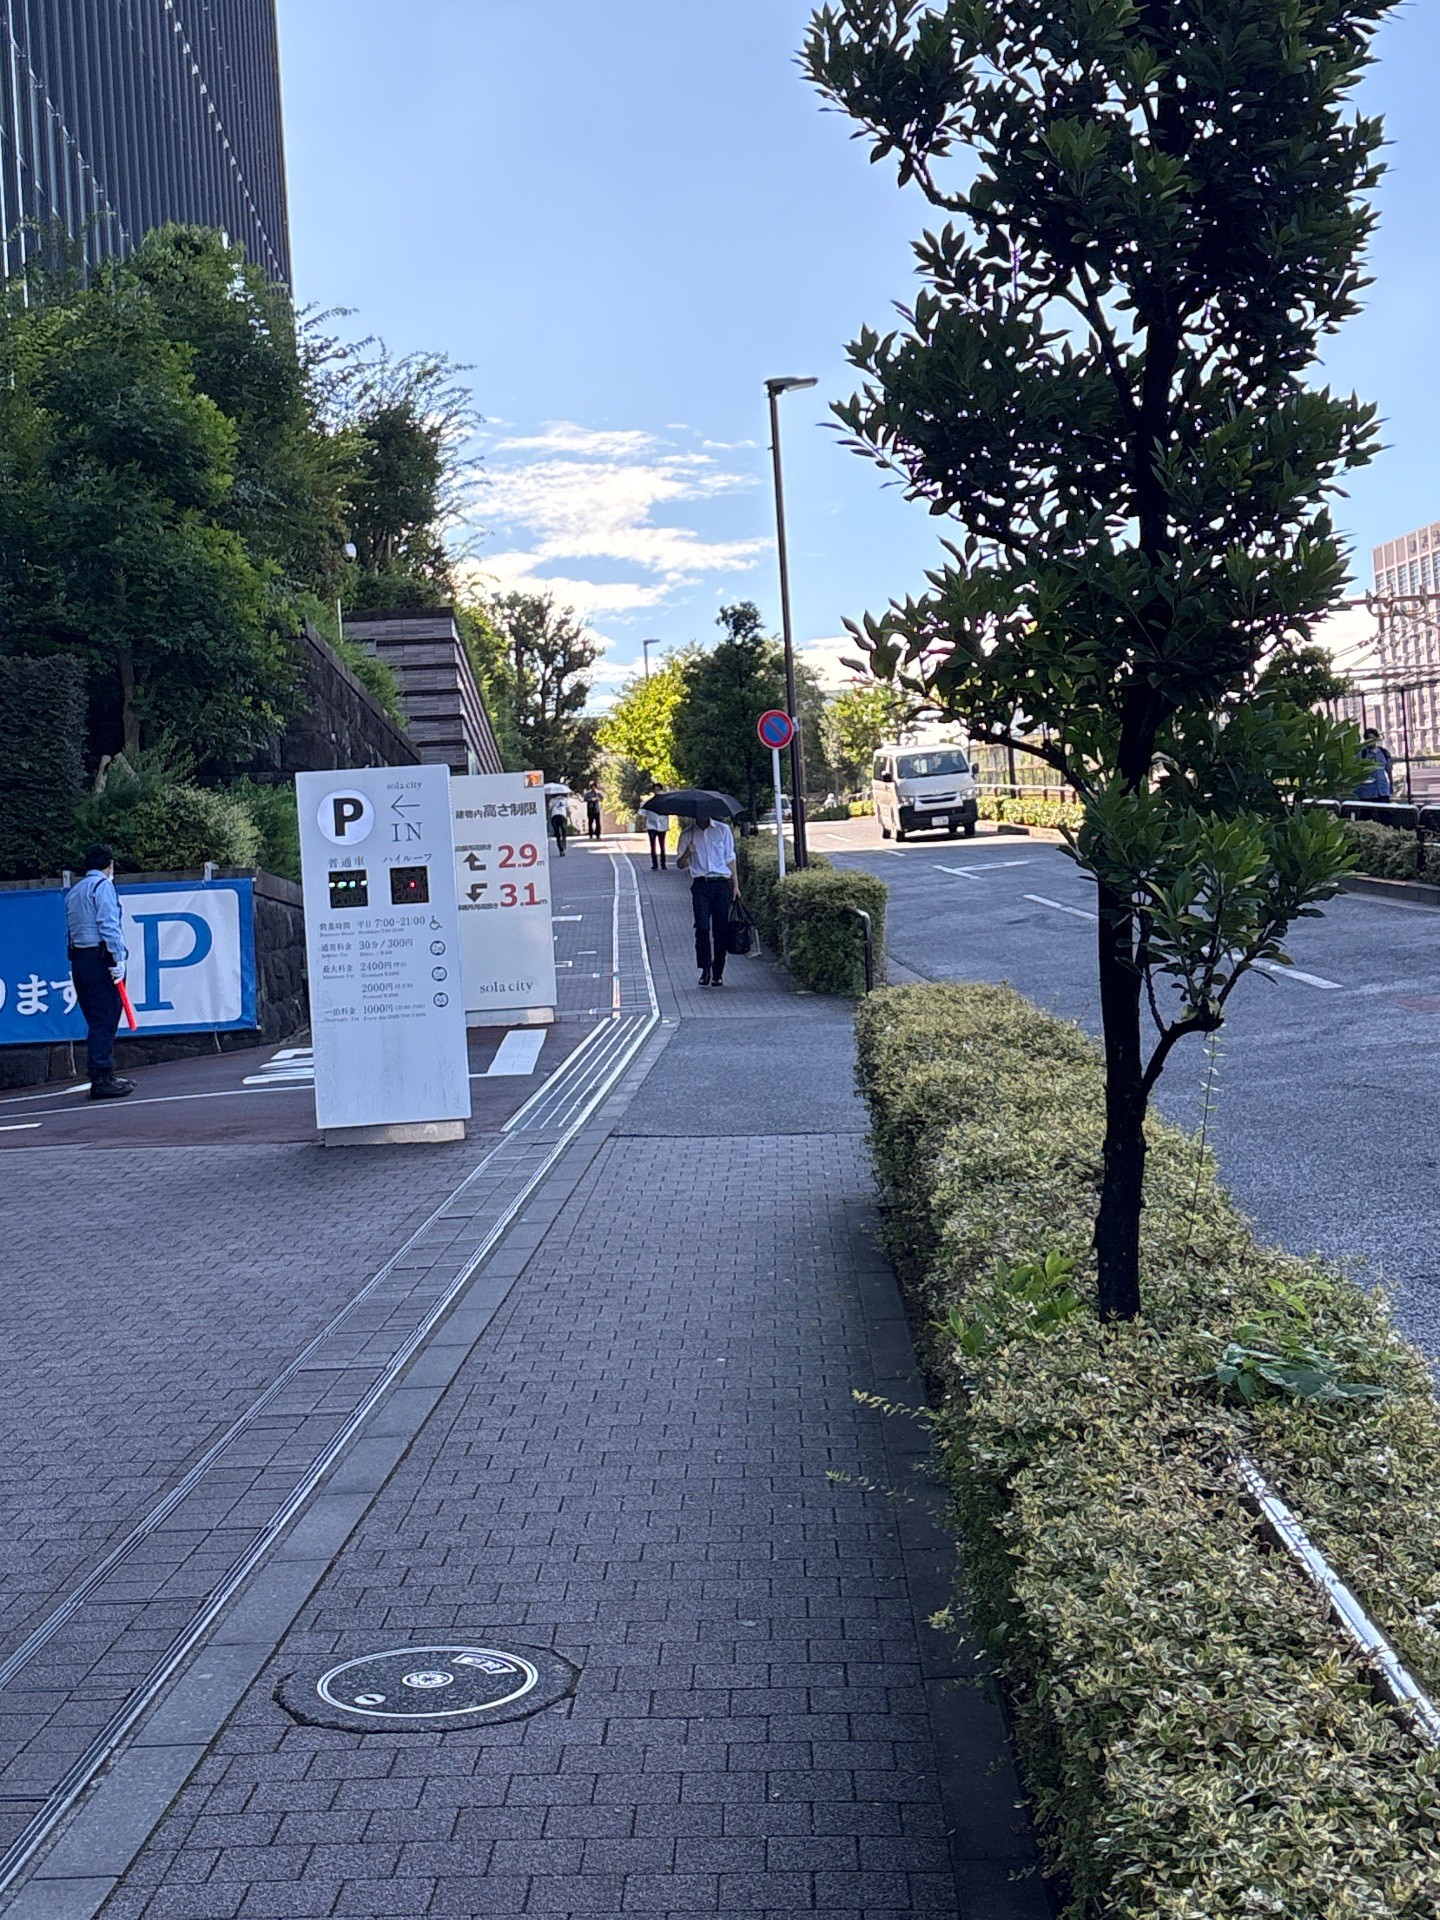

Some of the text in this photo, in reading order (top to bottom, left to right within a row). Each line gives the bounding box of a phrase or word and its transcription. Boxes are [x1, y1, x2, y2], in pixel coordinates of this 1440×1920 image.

[405, 781, 423, 790] city
[333, 797, 365, 837] P
[455, 801, 538, 819] 建物内高さ制限
[391, 822, 423, 842] IN
[328, 856, 365, 868] 普通車
[382, 853, 433, 864] ハイルーフ
[131, 911, 213, 1012] P
[0, 971, 78, 1015] ます
[479, 980, 534, 994] sola city
